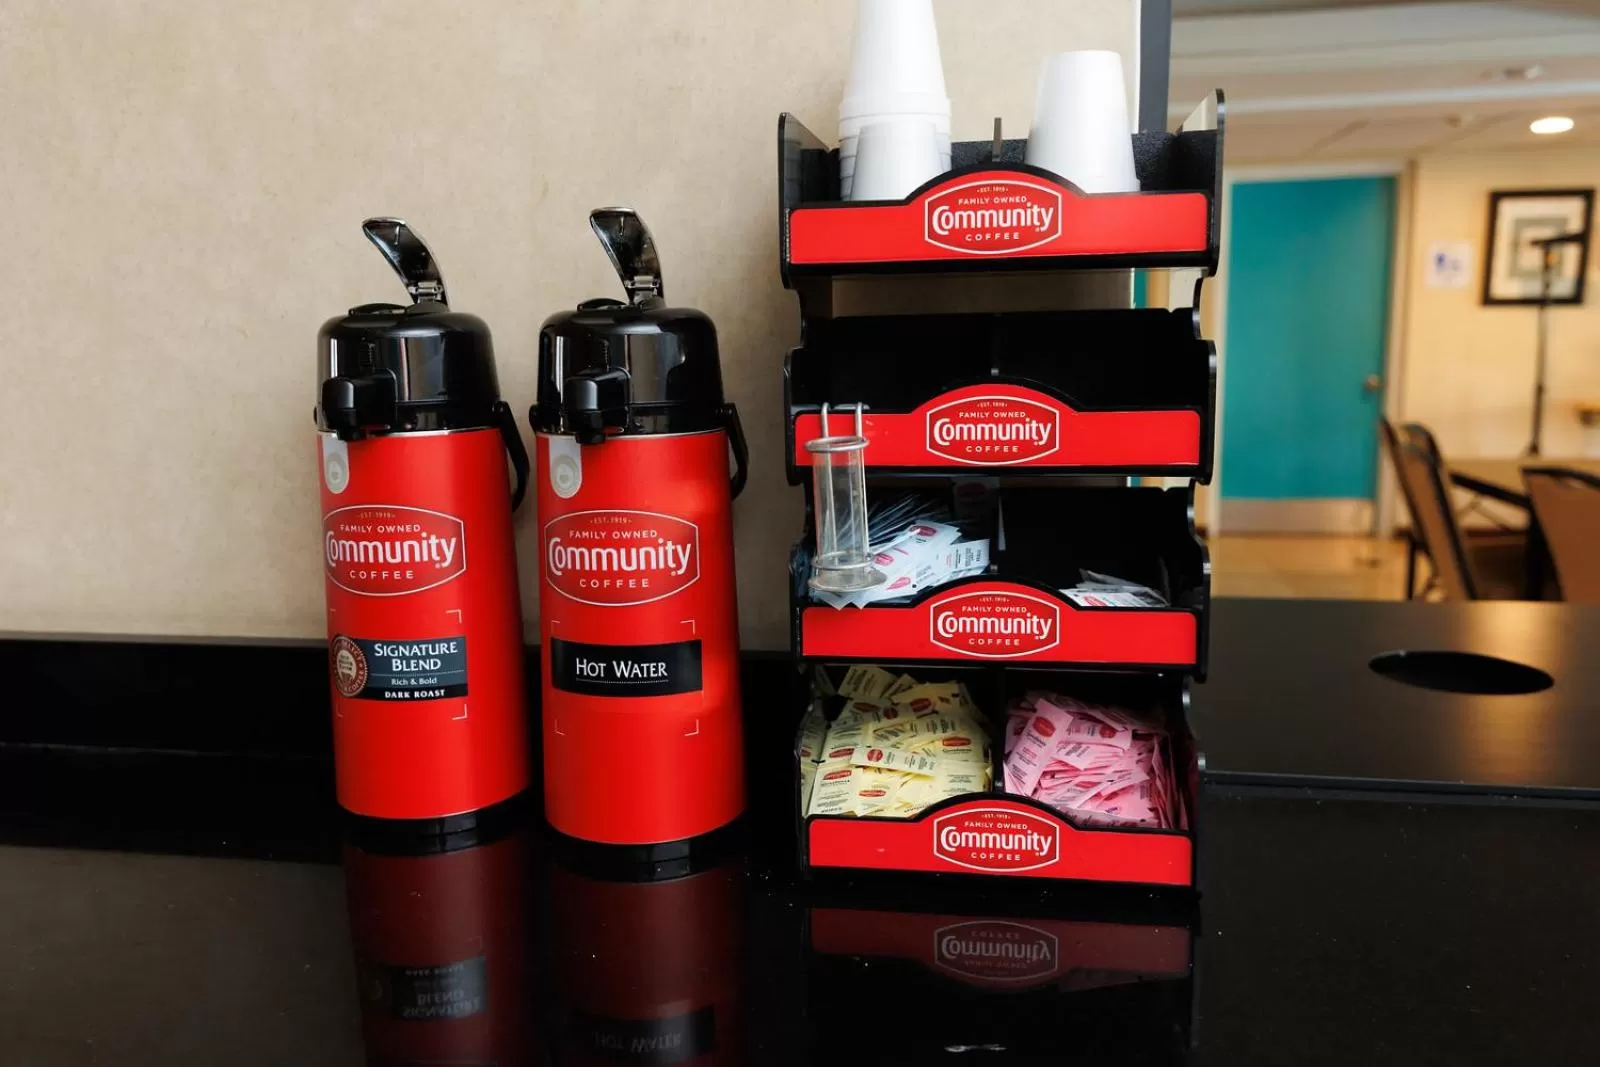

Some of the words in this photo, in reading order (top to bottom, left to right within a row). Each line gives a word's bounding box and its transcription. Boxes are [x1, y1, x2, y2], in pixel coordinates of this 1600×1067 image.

[958, 197, 989, 205] FAMILY
[993, 195, 1027, 204] OWNED
[932, 201, 1054, 235] Community
[965, 232, 1020, 241] COFFEE
[933, 417, 1051, 446] Community
[340, 524, 373, 532] FAMILY
[377, 524, 421, 532] OWNED
[569, 530, 607, 539] FAMILY
[612, 530, 657, 539] OWNED
[326, 531, 457, 568] Community
[549, 537, 692, 576] Community
[350, 570, 414, 580] COFFEE
[580, 579, 649, 588] COFFEE
[937, 611, 1052, 640] Community
[968, 638, 1020, 646] COFFEE
[374, 642, 458, 657] SIGNATURE
[392, 659, 441, 671] BLEND
[576, 657, 607, 678] HOT
[612, 660, 668, 678] WATER
[391, 678, 409, 686] Rich
[410, 678, 418, 686] &
[419, 677, 437, 686] Bold
[385, 690, 410, 699] DARK
[414, 689, 446, 699] ROAST
[964, 821, 993, 829] FAMILY
[997, 822, 1028, 830] OWNED
[941, 826, 1052, 856] Community
[971, 852, 1021, 861] COFFEE
